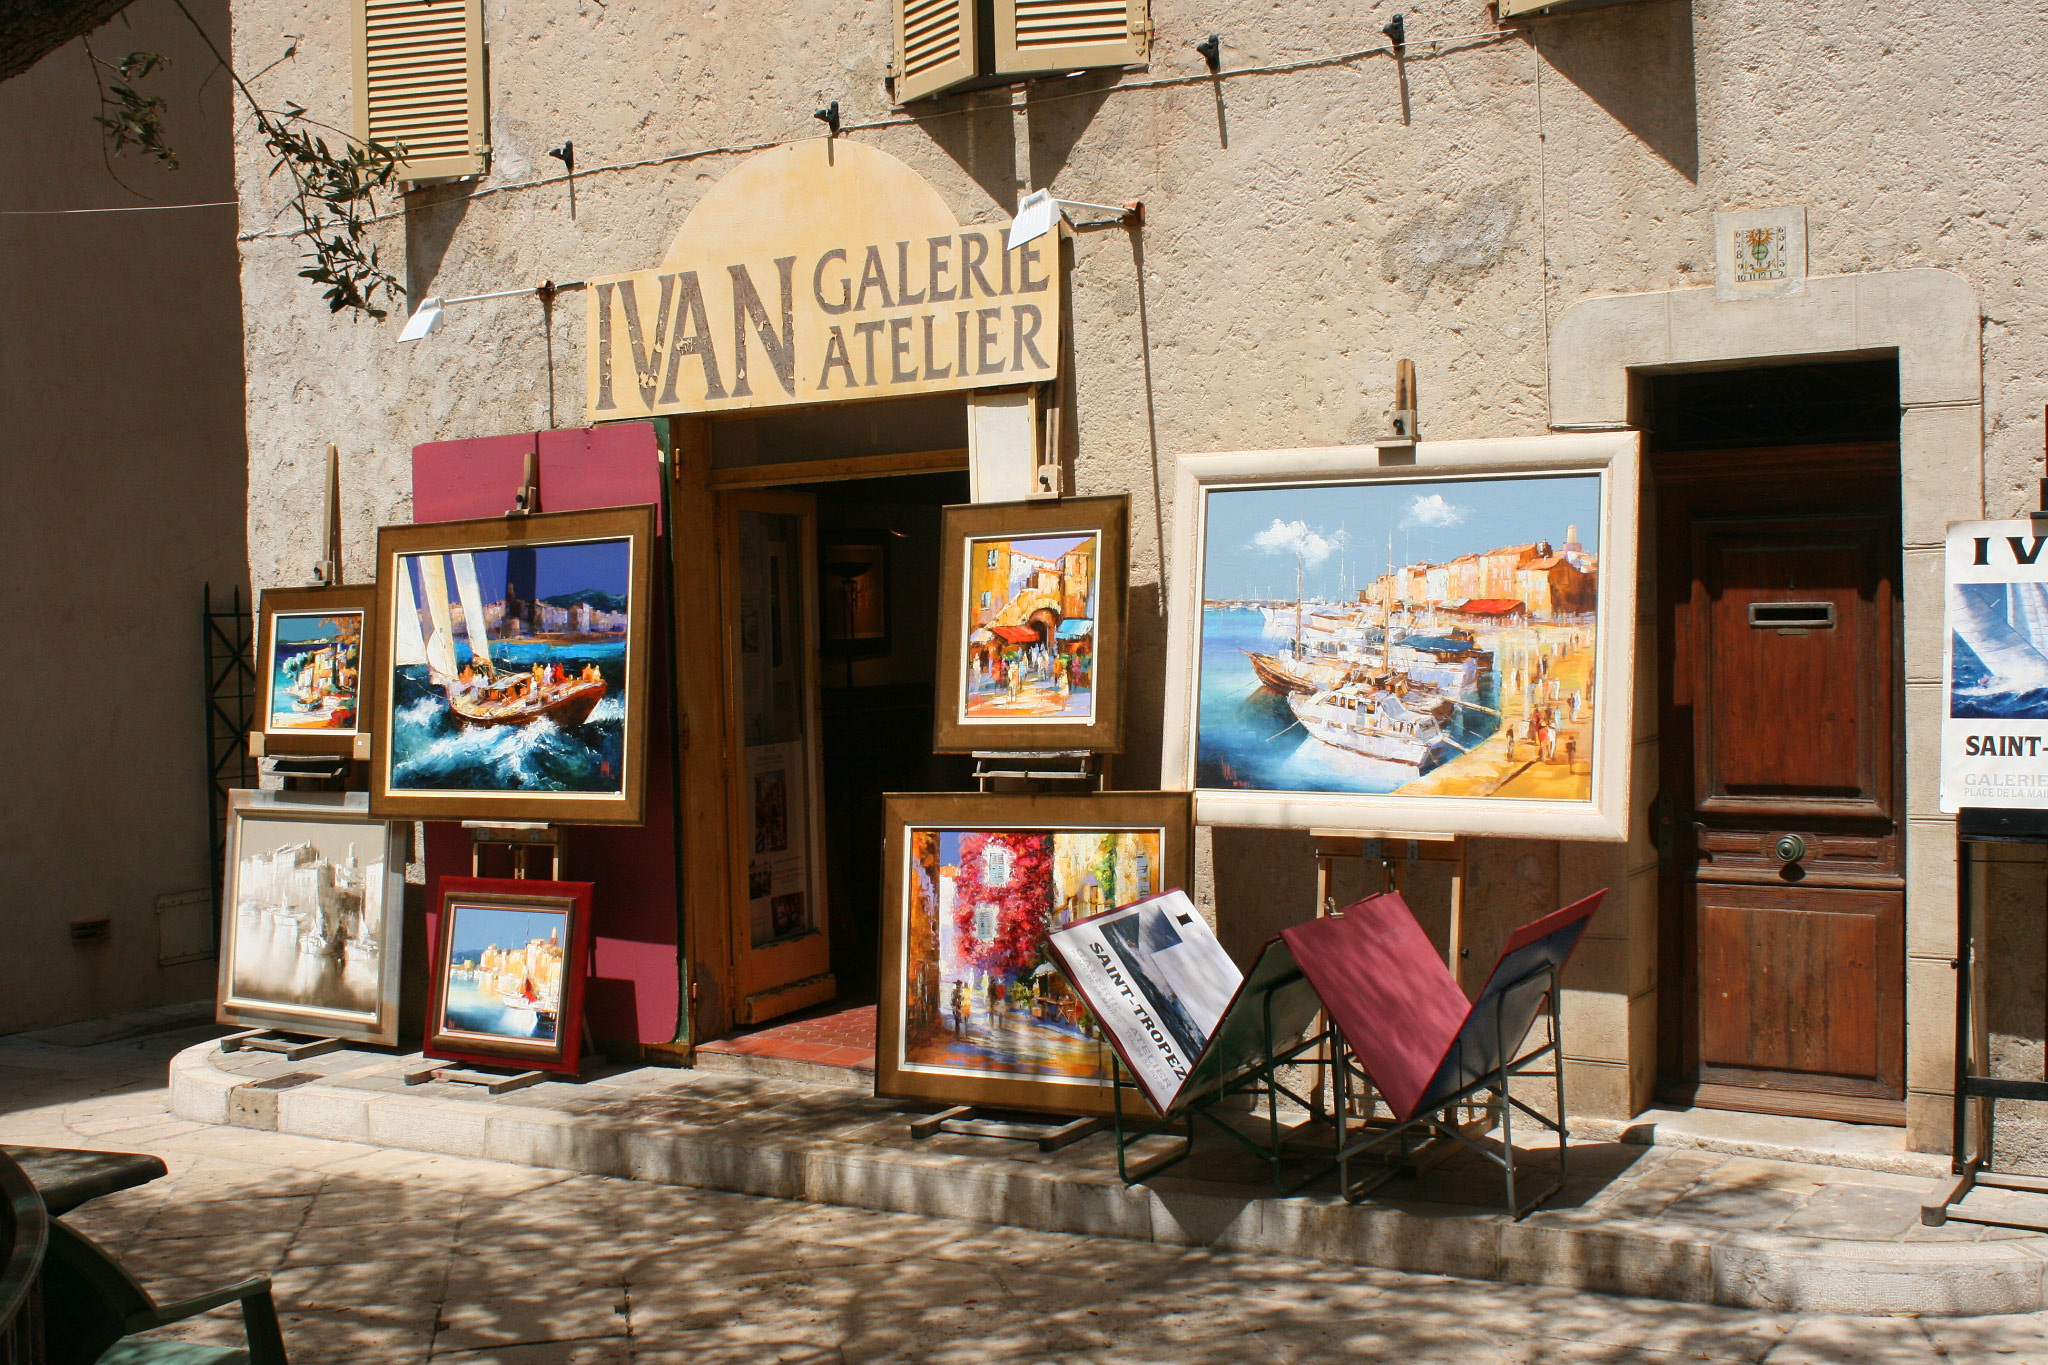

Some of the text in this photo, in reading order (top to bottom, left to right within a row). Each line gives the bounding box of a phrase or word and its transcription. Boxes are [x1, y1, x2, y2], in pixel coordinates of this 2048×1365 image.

[813, 229, 1050, 315] GALERIE
[595, 256, 797, 412] IVAN
[816, 304, 1050, 391] ATELIER
[1964, 773, 2048, 787] GALERIE
[1965, 735, 2048, 757] SAINT-
[1964, 787, 1994, 797] PLACE
[1996, 788, 2008, 798] DE
[2011, 788, 2024, 798] LA
[1076, 948, 1172, 1088] GALERIE ATELIER
[1089, 942, 1188, 1081] SAINT-TROPEZ
